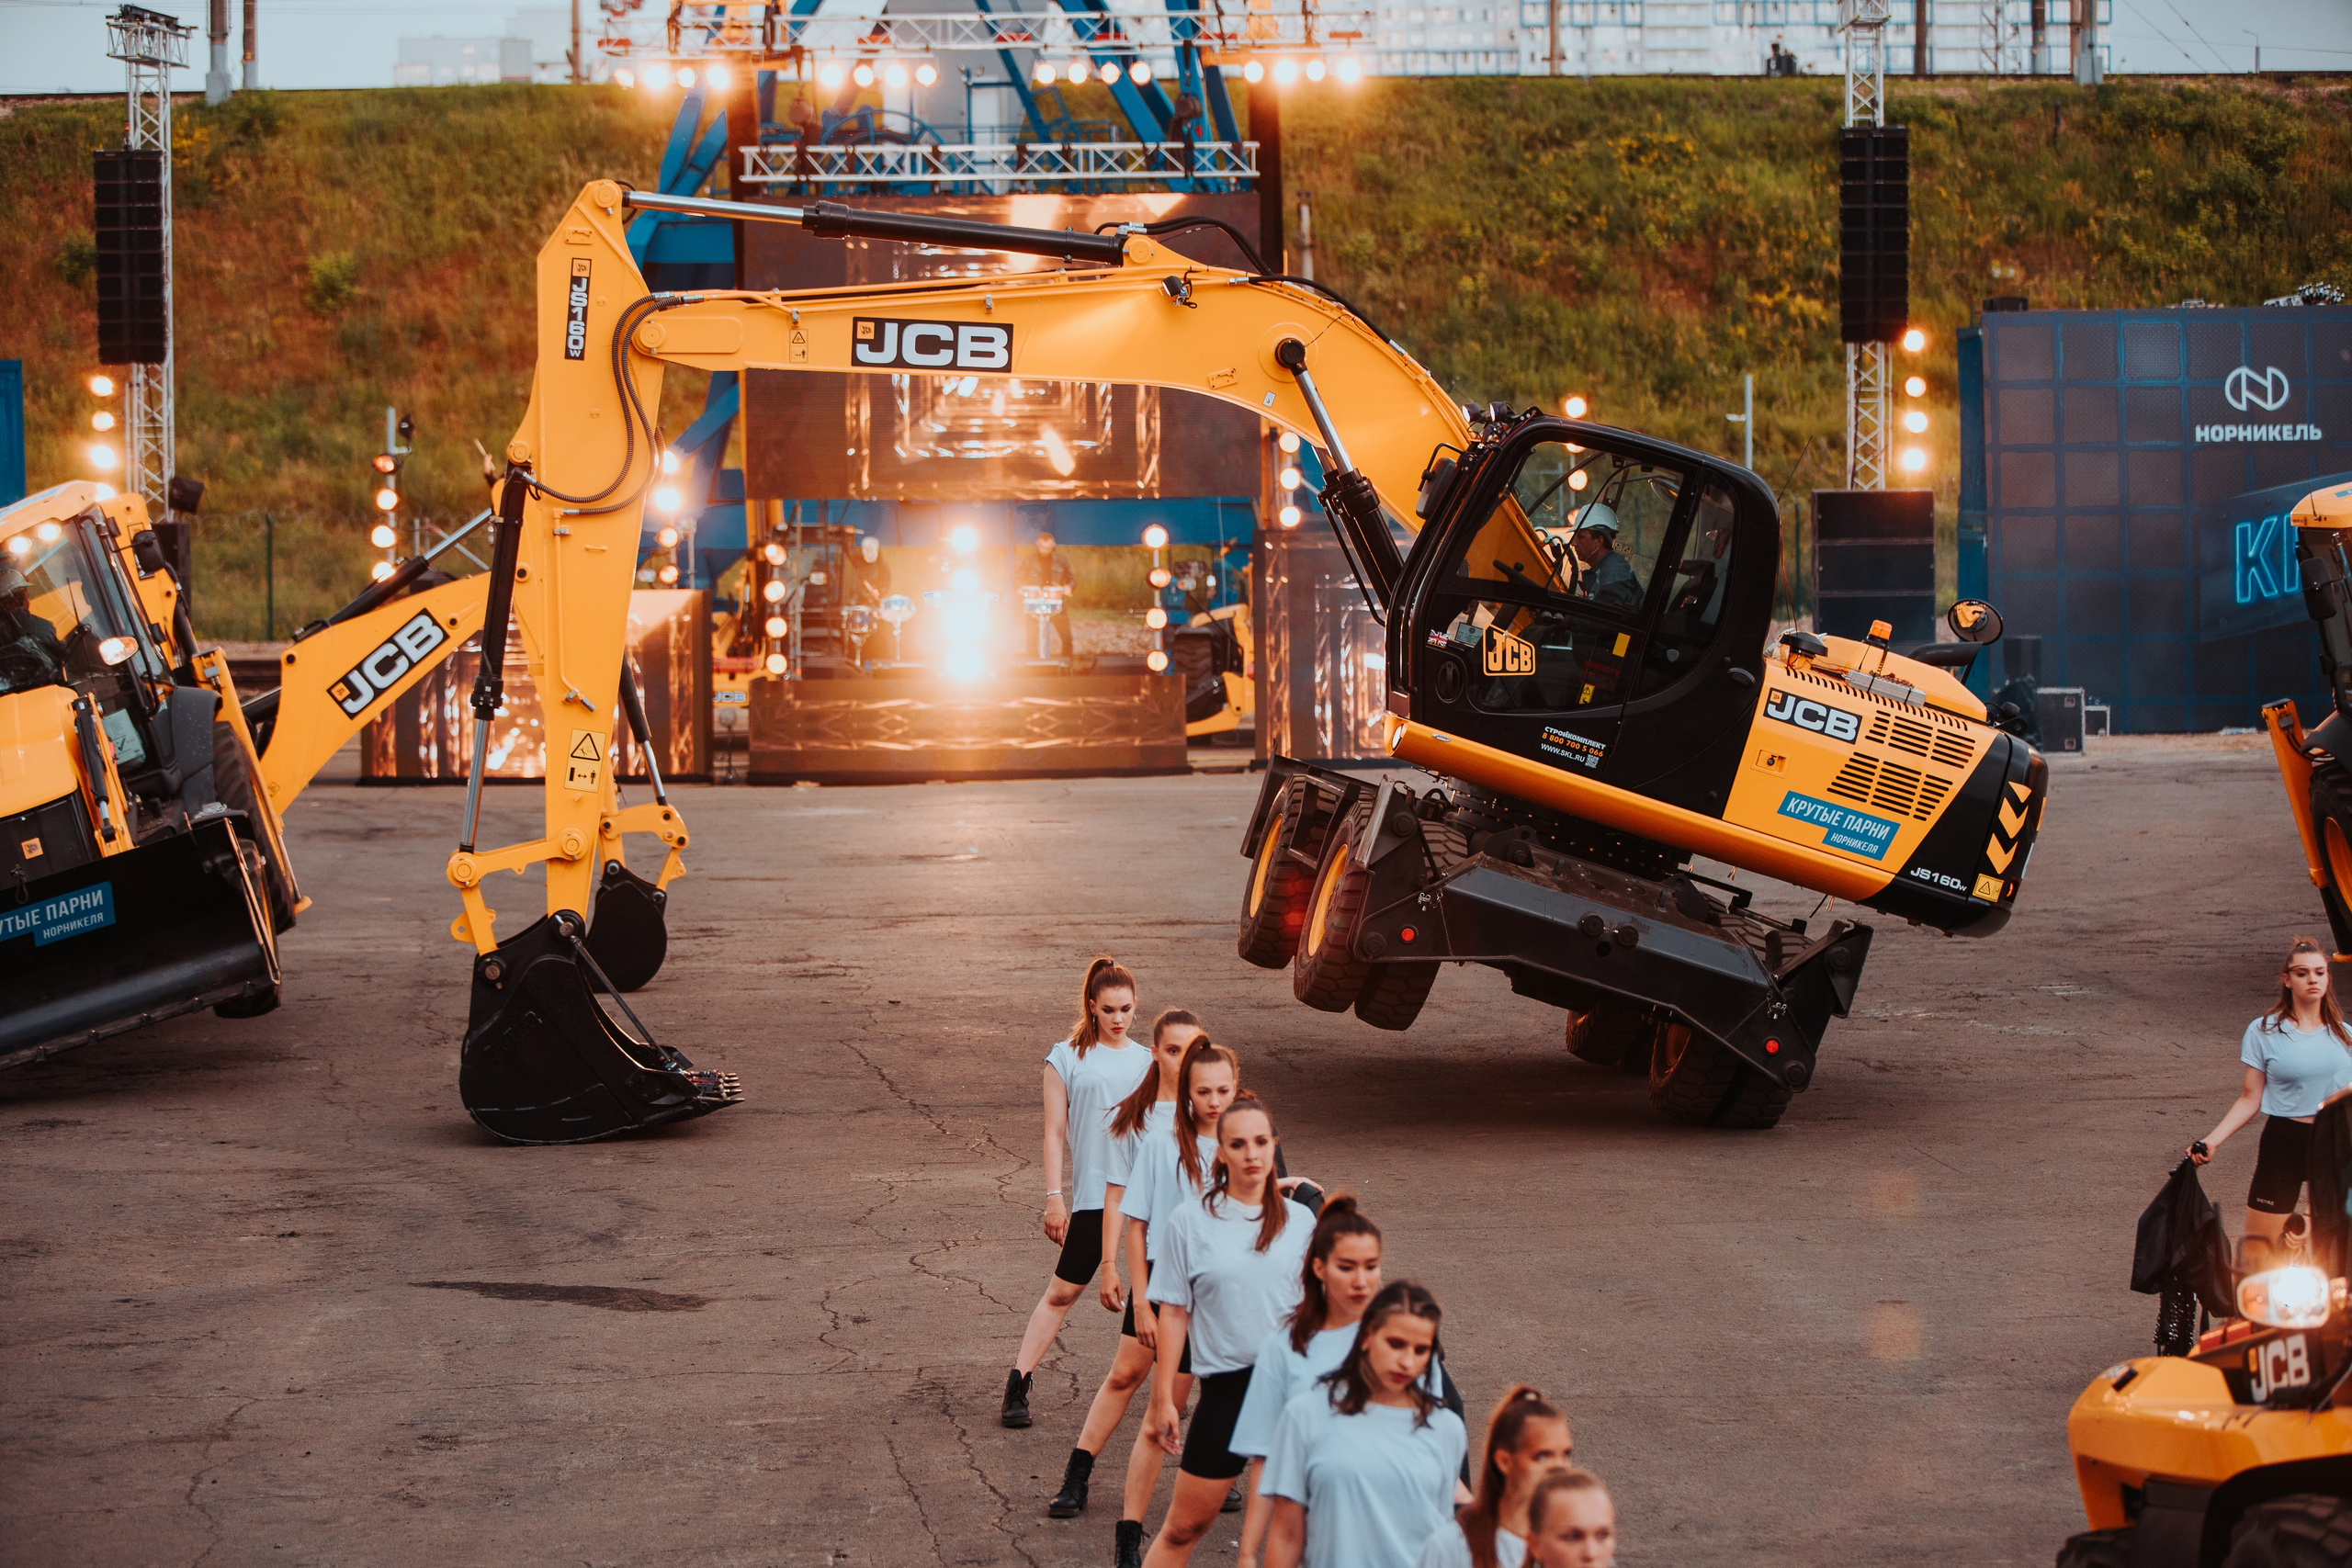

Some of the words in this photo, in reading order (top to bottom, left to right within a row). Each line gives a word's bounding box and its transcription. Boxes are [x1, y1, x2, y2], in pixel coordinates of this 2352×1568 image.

[855, 321, 1009, 368] JCB
[2195, 423, 2323, 443] НОРНИКЕЛЬ
[342, 615, 444, 714] JCB
[1487, 630, 1532, 672] JCB
[712, 691, 746, 703] JCB
[1767, 694, 1859, 741] JCB
[1541, 743, 1586, 762] WWW.SKL.RU
[1544, 726, 1606, 750] СТРОЙКОМПЛЕКТ
[1549, 734, 1564, 745] 800
[1566, 739, 1580, 750] 700
[1589, 747, 1604, 758] 066
[1786, 797, 1844, 827] КРУТЫЕ
[1842, 814, 1891, 840] ПАРНИ
[1830, 832, 1880, 854] НОРНИКЕЛЯ
[46, 889, 104, 921] ПАРНИ
[43, 912, 104, 939] НОРНИКЕЛЯ
[2250, 1333, 2311, 1403] JCB
